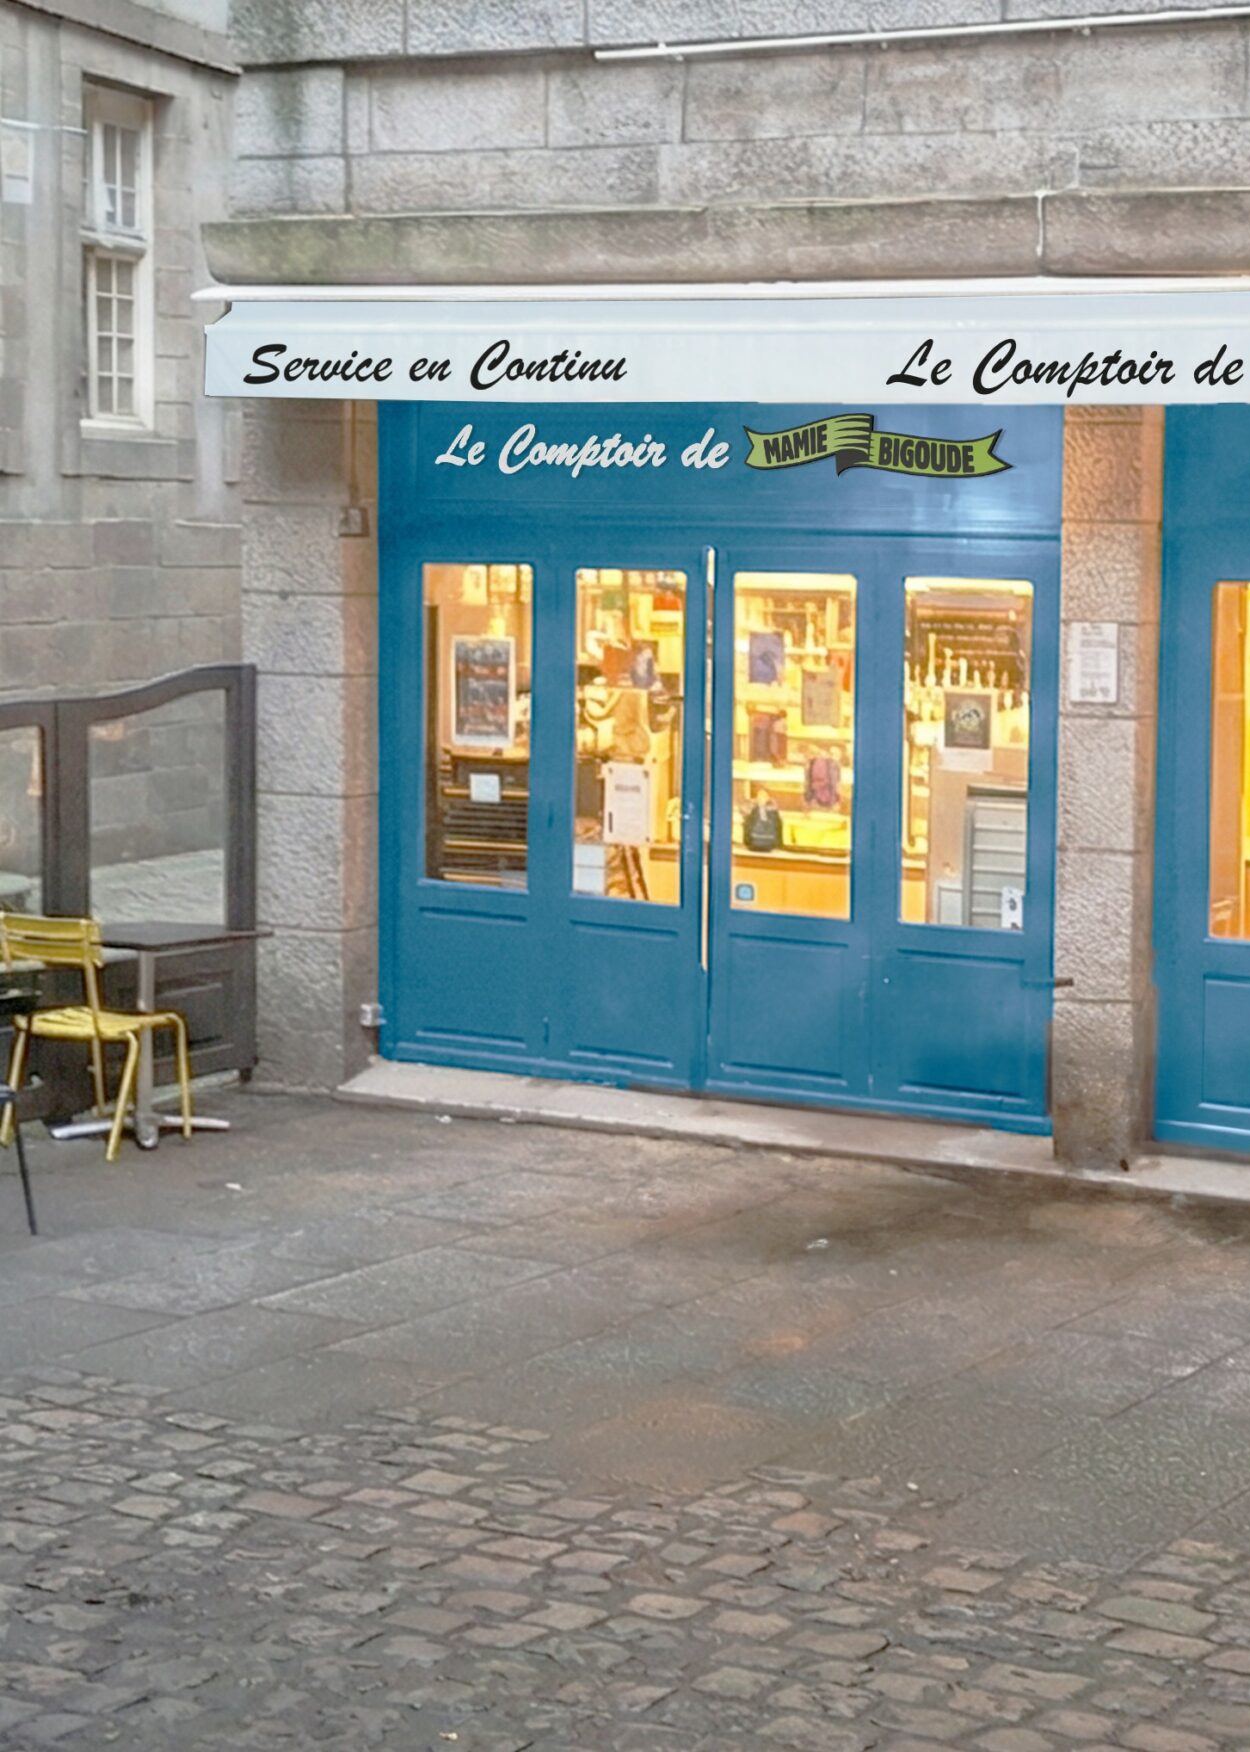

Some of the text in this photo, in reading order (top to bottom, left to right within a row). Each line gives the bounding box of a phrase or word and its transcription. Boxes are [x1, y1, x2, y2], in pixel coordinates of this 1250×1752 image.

[242, 339, 628, 391] Service en Continu
[885, 338, 952, 387] Le
[972, 338, 1176, 398] Comptoir
[1193, 343, 1244, 386] de
[434, 422, 976, 479] Le Comptoir de MAMIE BIGOUDE
